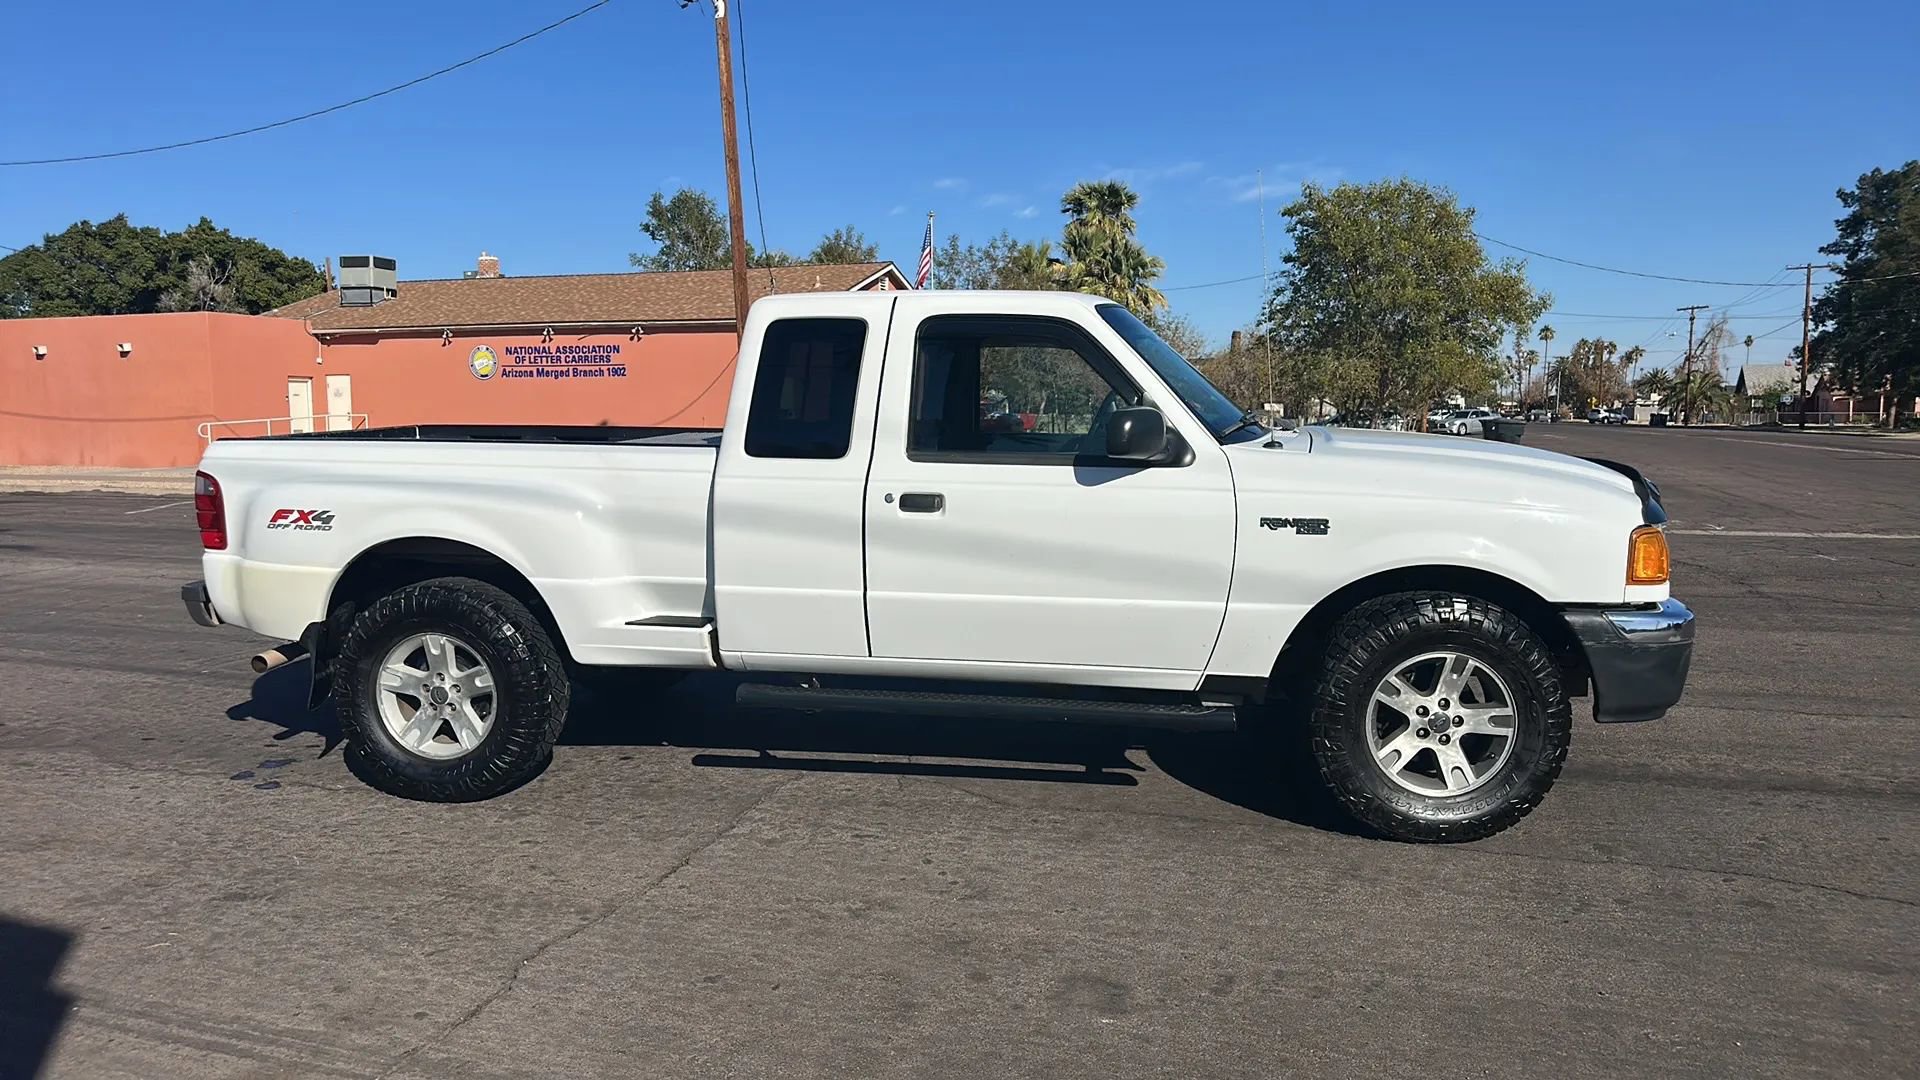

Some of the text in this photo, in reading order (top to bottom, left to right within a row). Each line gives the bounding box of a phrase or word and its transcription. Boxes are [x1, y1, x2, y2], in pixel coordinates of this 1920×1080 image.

[505, 345, 620, 355] NATIONAL ASSOCIATION
[514, 354, 611, 364] OF LETTER CARRIERS
[501, 367, 627, 380] Arizona Merged Branch 1902
[269, 509, 336, 524] FX4
